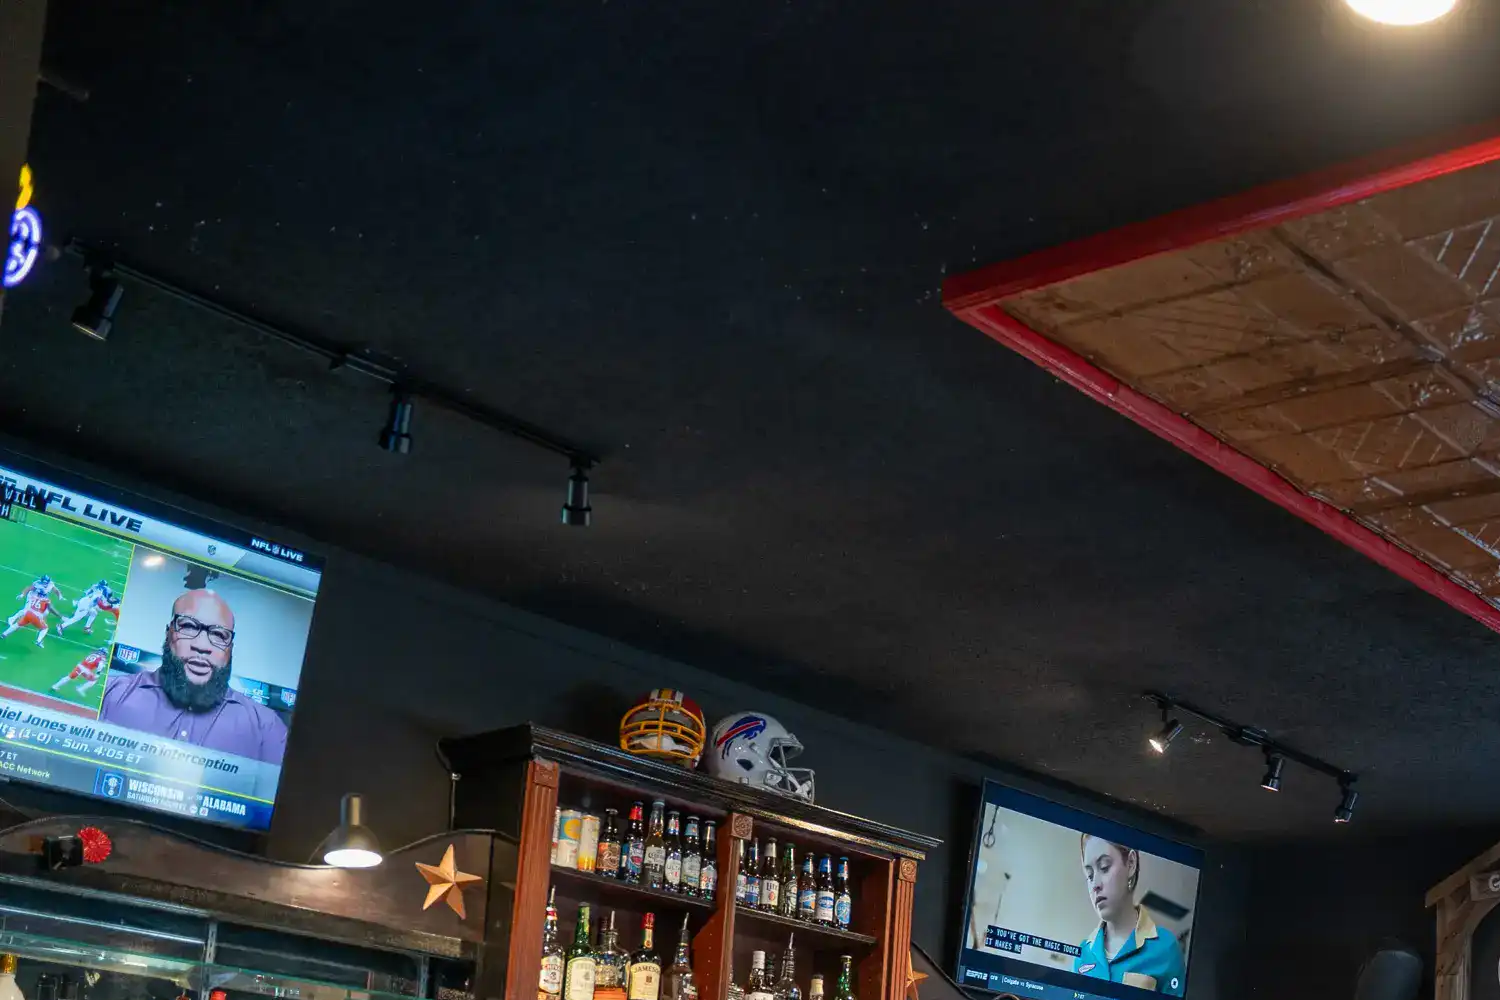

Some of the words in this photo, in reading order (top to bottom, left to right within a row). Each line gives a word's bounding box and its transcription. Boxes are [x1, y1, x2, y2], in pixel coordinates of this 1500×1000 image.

[4, 484, 37, 509] WILL
[83, 503, 143, 533] LIVE
[251, 538, 272, 552] NFL
[280, 548, 304, 562] LIVE
[23, 714, 68, 733] Jones
[69, 725, 96, 739] will
[97, 730, 140, 750] throw
[140, 742, 158, 754] an
[159, 744, 240, 774] interception
[62, 738, 91, 753] Sun.
[93, 746, 124, 760] 4:05
[125, 752, 143, 764] ET
[16, 764, 51, 779] Network
[128, 778, 185, 799] WISCONSIN
[202, 795, 247, 816] ALABAMA
[985, 937, 992, 945] IT
[994, 939, 1012, 950] MAKES
[1014, 944, 1021, 952] ME
[996, 928, 1017, 940] YOU'VE
[1019, 933, 1029, 944] GOT
[1032, 937, 1042, 946] THE
[1044, 940, 1060, 951] MAGIC
